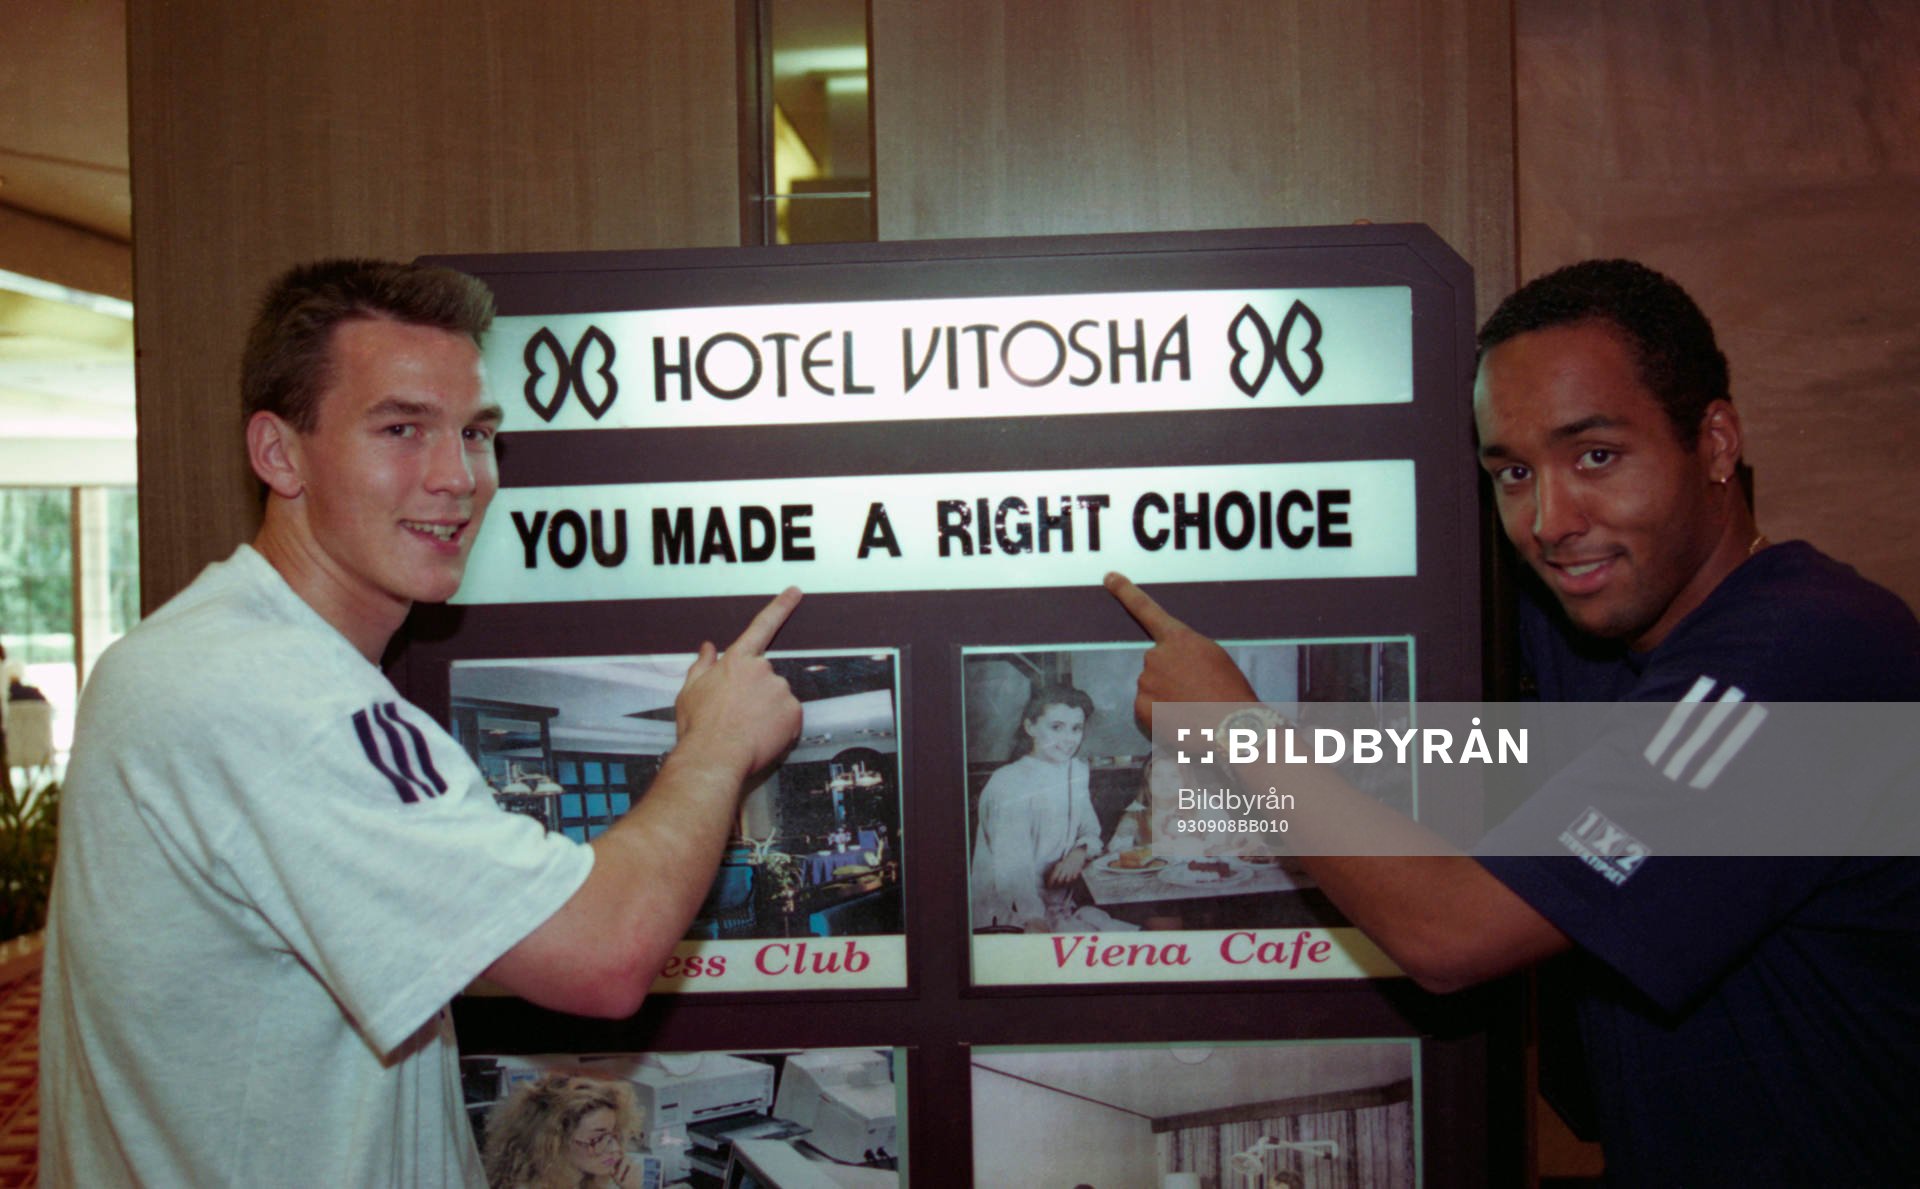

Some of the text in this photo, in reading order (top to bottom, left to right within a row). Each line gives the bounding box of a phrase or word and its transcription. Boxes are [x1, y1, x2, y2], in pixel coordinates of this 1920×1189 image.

[652, 314, 1191, 402] HOTEL VITOSHA
[511, 489, 1353, 568] YOU MADE A RIGHT CHOICE
[755, 941, 870, 976] Club
[1051, 931, 1332, 970] Viena Cafe
